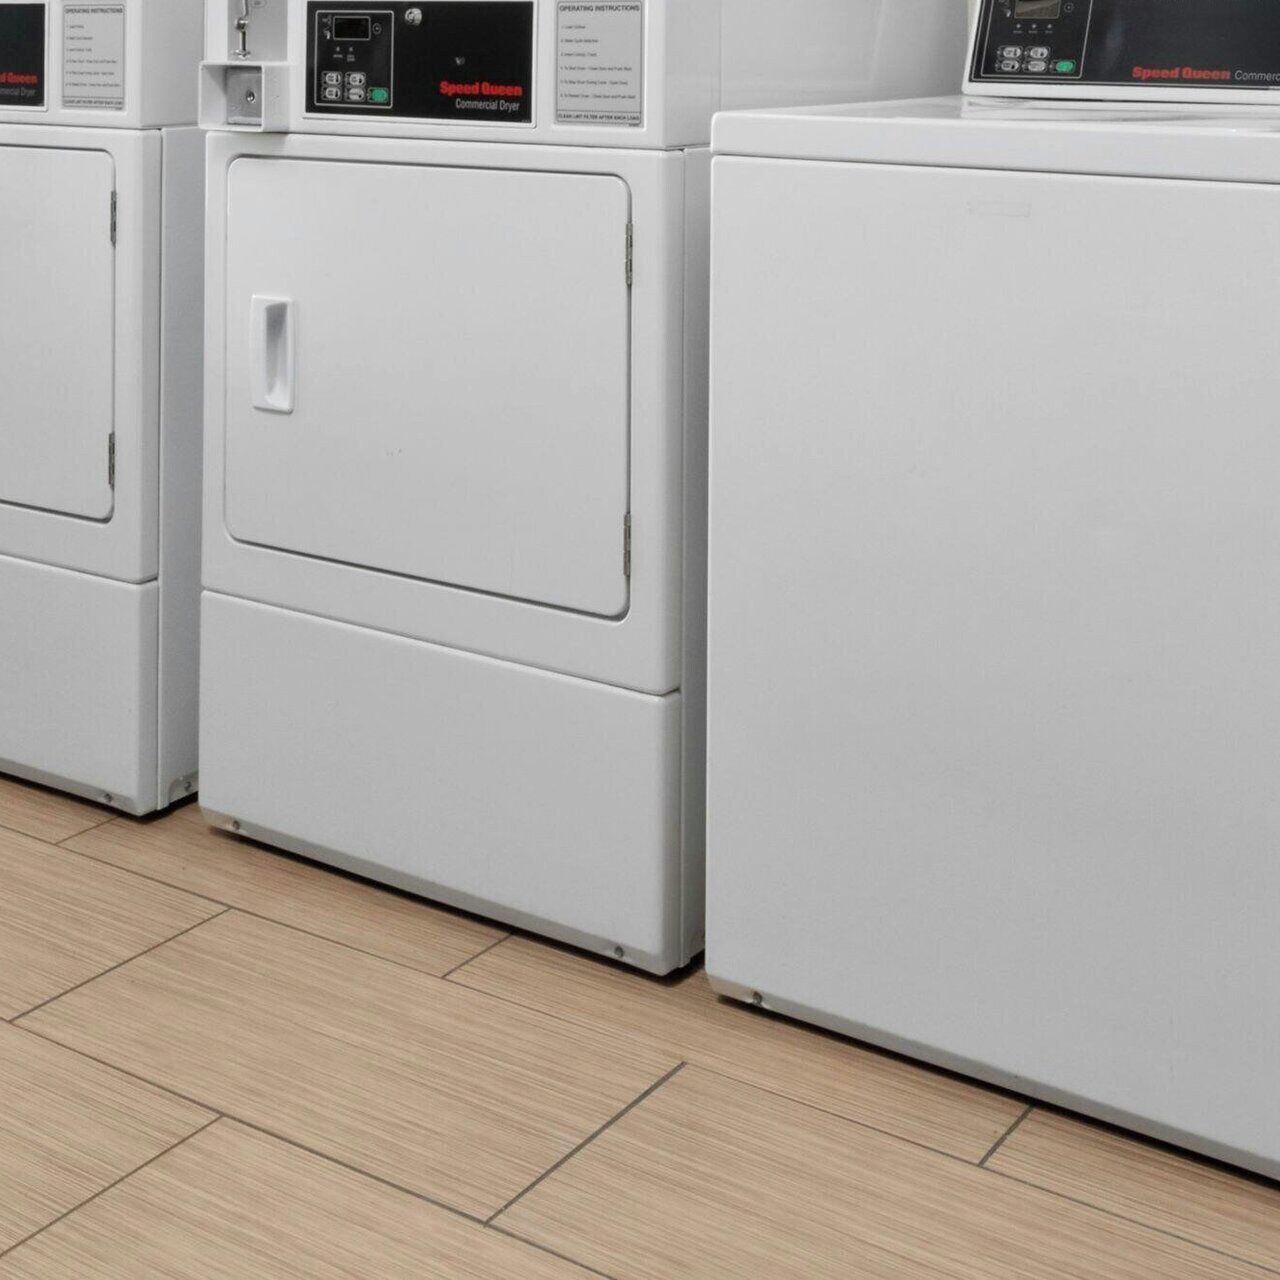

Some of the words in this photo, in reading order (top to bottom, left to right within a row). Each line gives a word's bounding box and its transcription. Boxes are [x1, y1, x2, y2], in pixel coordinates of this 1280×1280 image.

[1133, 67, 1180, 80] Speed
[1182, 67, 1231, 80] Queen
[440, 81, 480, 96] Speed
[481, 82, 522, 95] Queen
[455, 98, 498, 110] Commercial
[500, 99, 520, 111] Dryer
